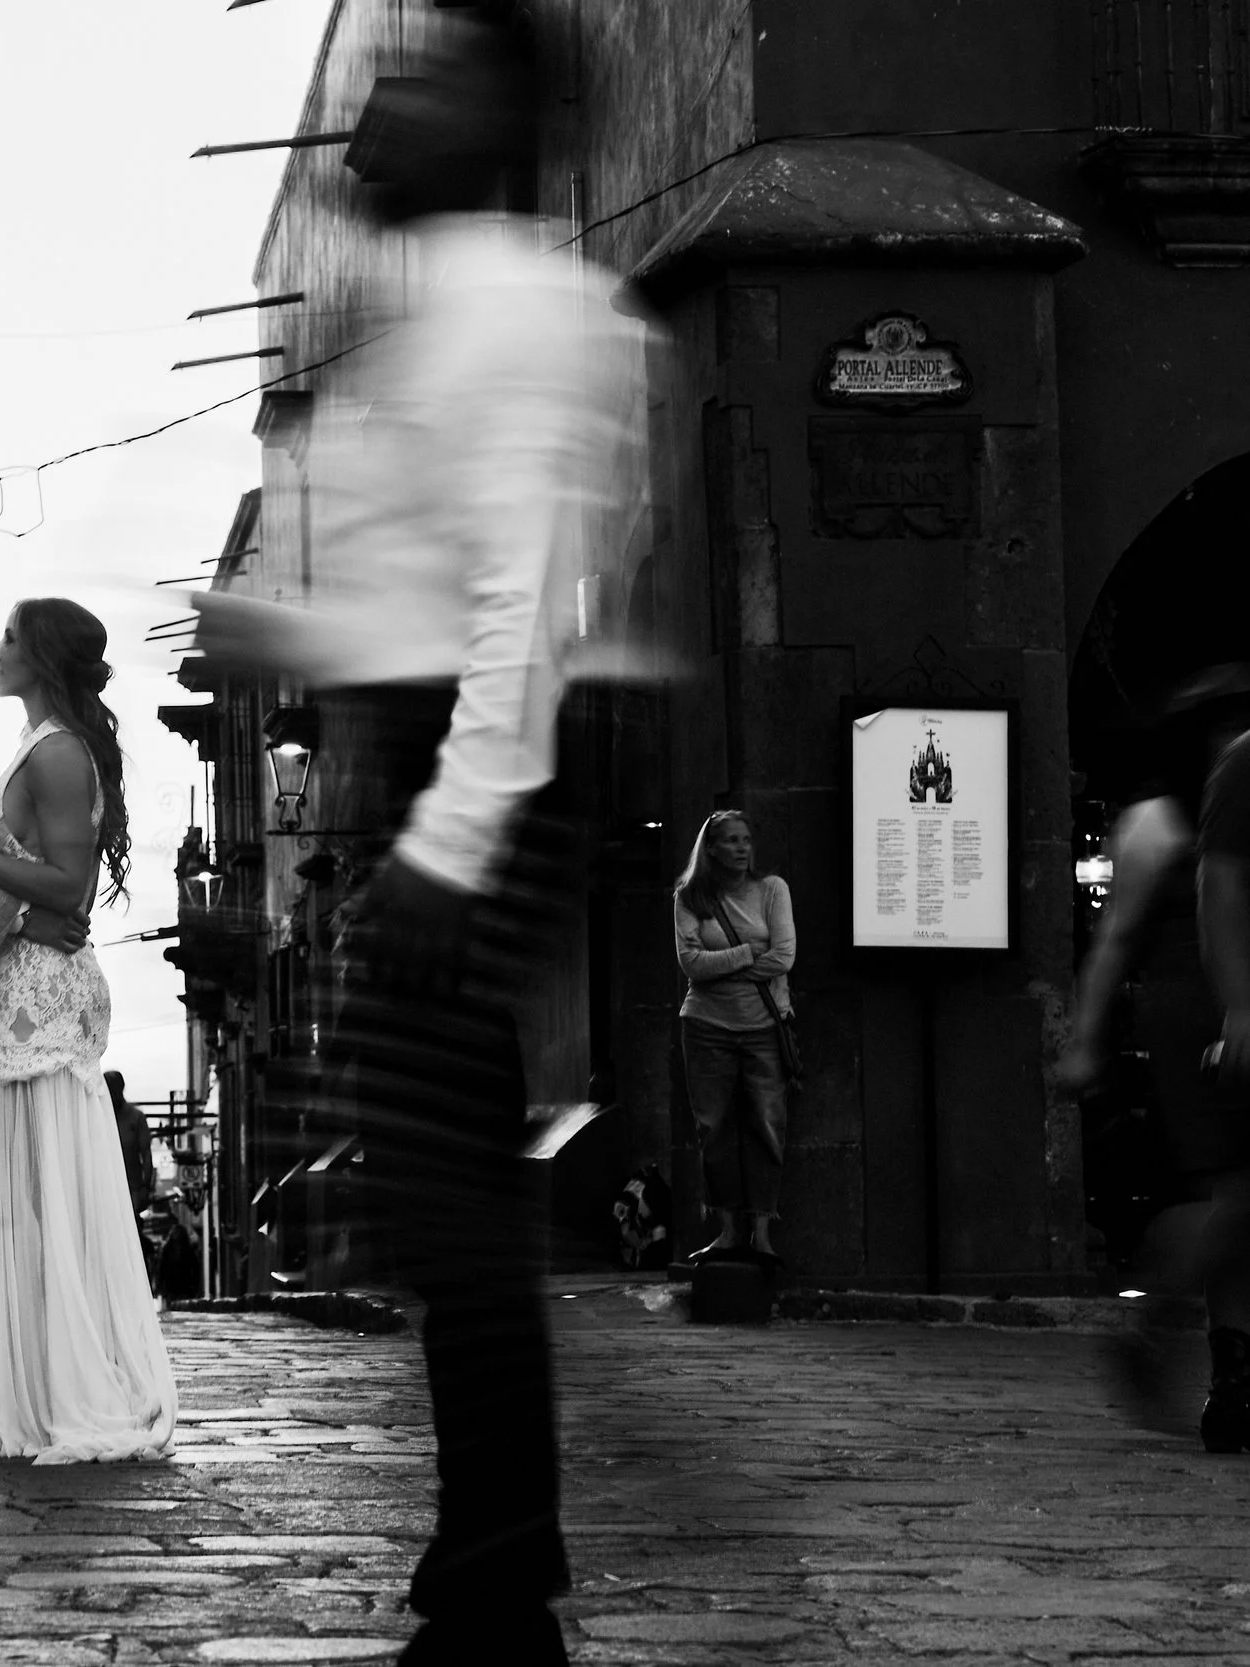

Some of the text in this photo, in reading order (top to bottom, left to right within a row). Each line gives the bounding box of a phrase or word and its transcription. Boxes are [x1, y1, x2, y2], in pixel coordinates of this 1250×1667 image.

[838, 360, 942, 377] PORTAL ALLENDE
[835, 472, 955, 496] ALLENDE
